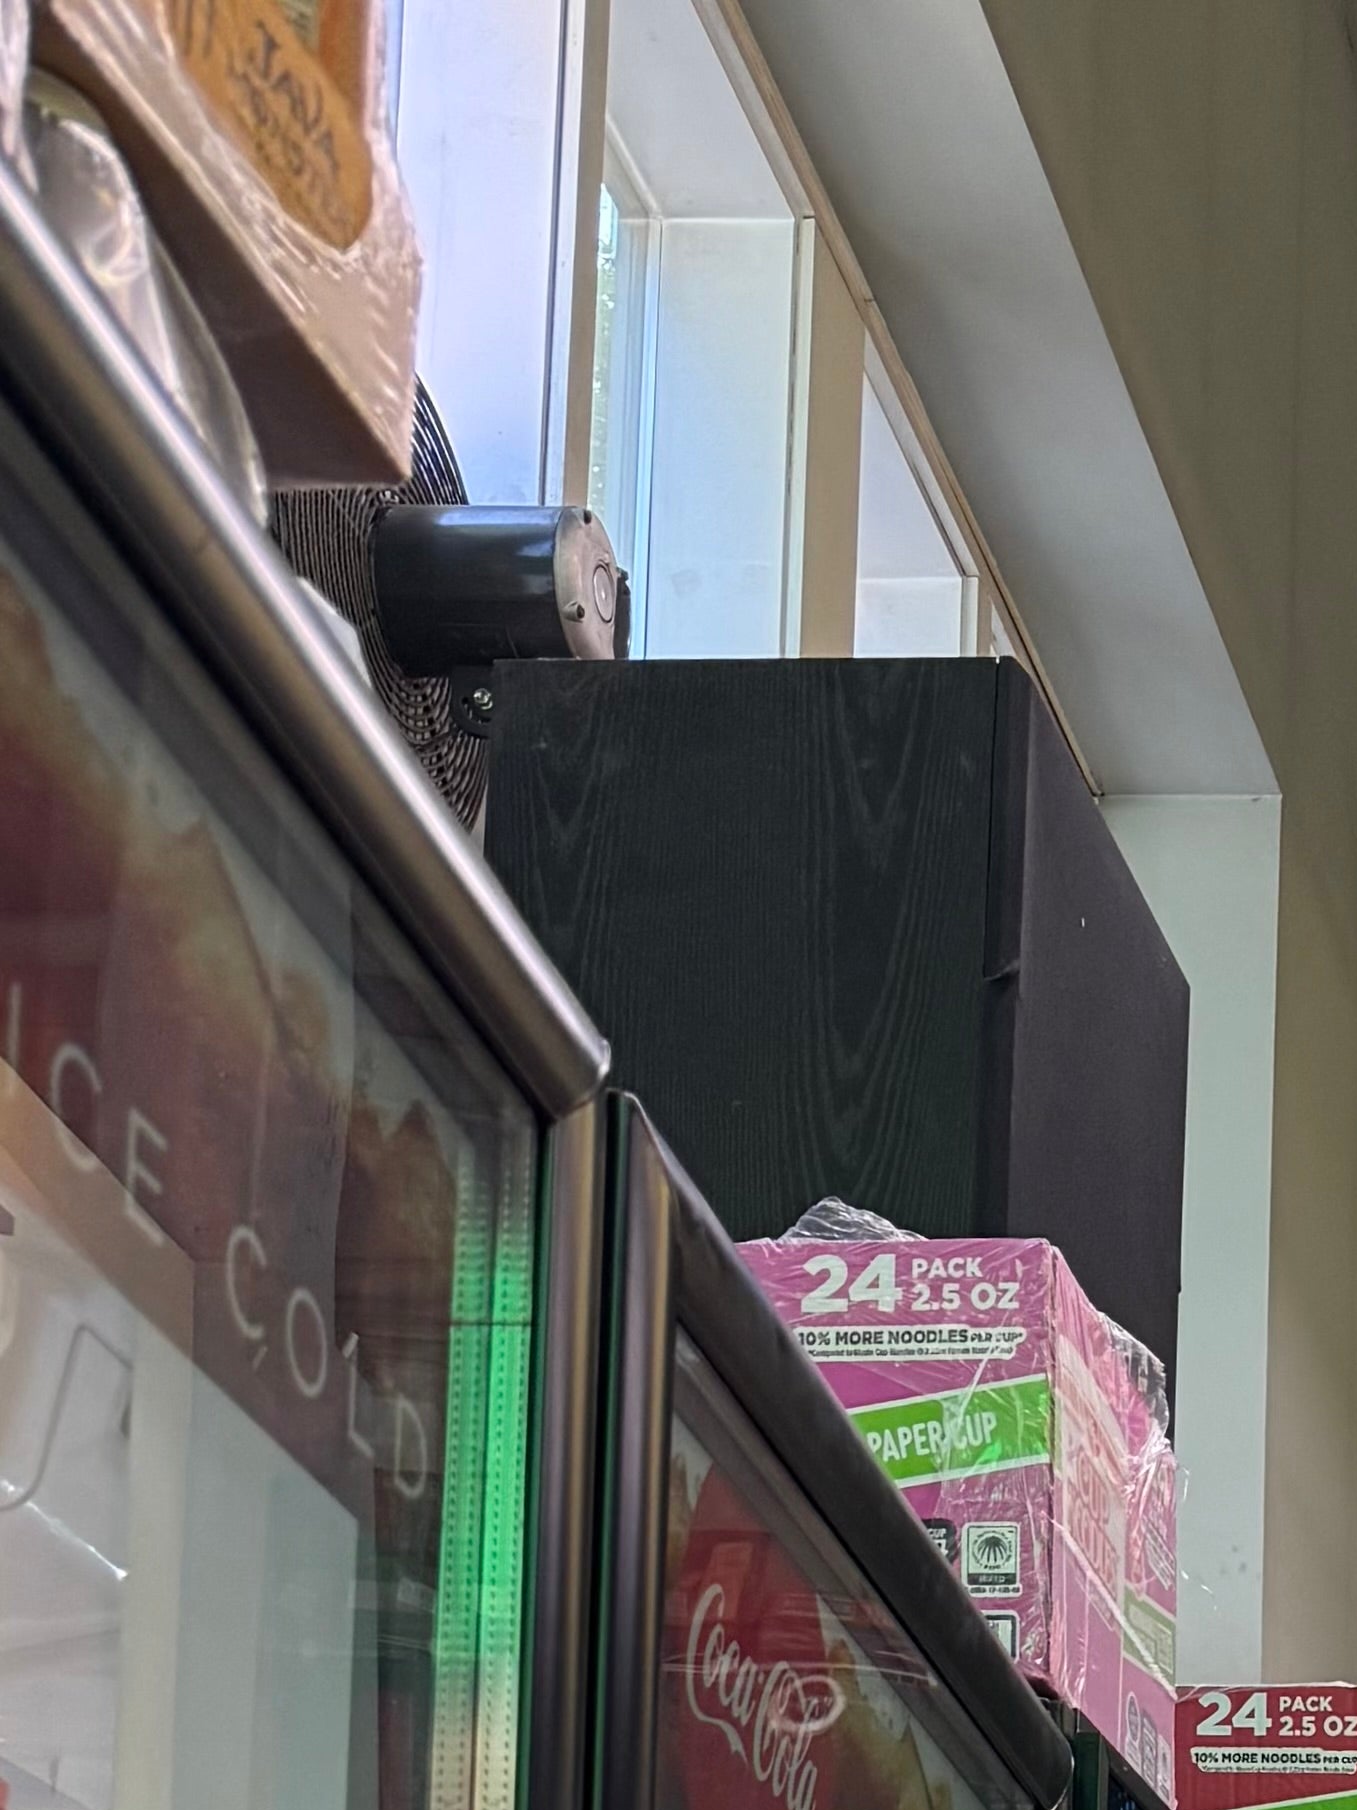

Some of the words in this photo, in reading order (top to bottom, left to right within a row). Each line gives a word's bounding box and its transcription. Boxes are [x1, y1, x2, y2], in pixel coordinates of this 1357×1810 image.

[912, 1257, 983, 1278] PACK
[801, 1254, 902, 1313] 24
[911, 1283, 961, 1311] 2.5
[971, 1283, 1020, 1310] OZ
[836, 1331, 884, 1345] MORE
[888, 1329, 968, 1344] NOODLES
[225, 1227, 427, 1499] COLD
[868, 1421, 945, 1462] PAPER
[948, 1412, 997, 1449] CUP
[1196, 1692, 1272, 1736] 24
[1279, 1697, 1332, 1712] PACK
[1279, 1716, 1316, 1736] 2.5
[1194, 1753, 1218, 1763] 10%
[1222, 1753, 1258, 1764] MORE
[1261, 1753, 1321, 1764] NOODLES
